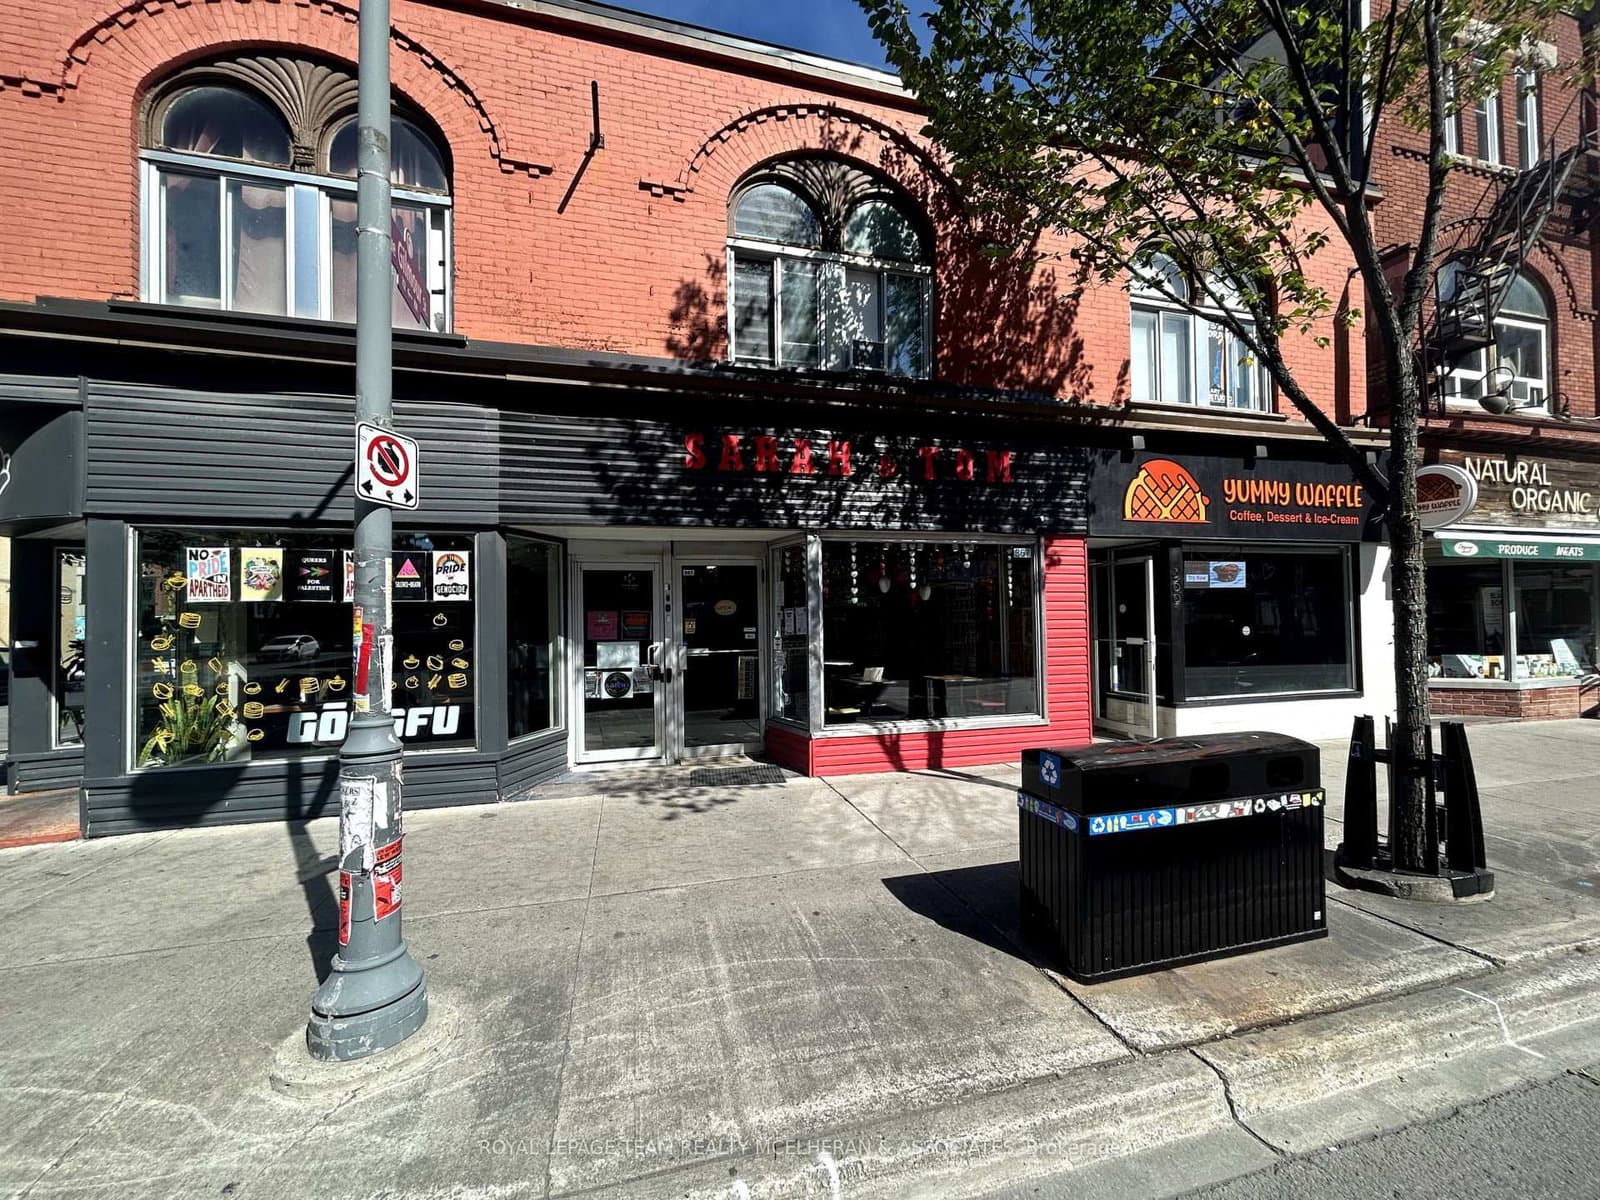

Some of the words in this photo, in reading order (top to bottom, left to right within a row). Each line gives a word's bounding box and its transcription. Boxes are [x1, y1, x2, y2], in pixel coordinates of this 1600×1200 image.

[684, 434, 852, 477] SARAH
[918, 446, 1013, 484] TOM
[1465, 457, 1552, 486] NATURAL
[1223, 479, 1291, 506] YUMMY
[1296, 483, 1363, 508] WAFFLE
[1512, 487, 1592, 513] ORGANIC
[1229, 510, 1265, 523] Coffee,
[1267, 511, 1303, 523] Dessert
[1305, 514, 1312, 523] &
[1314, 513, 1359, 525] Ice-Cream
[189, 549, 209, 561] NO
[1498, 544, 1540, 556] PRODUCE
[1556, 546, 1584, 557] MEATS
[189, 553, 228, 578] PRIDE
[435, 563, 466, 575] PRIDE
[189, 579, 229, 598] APARTHEID
[287, 702, 461, 743] GŌFU
